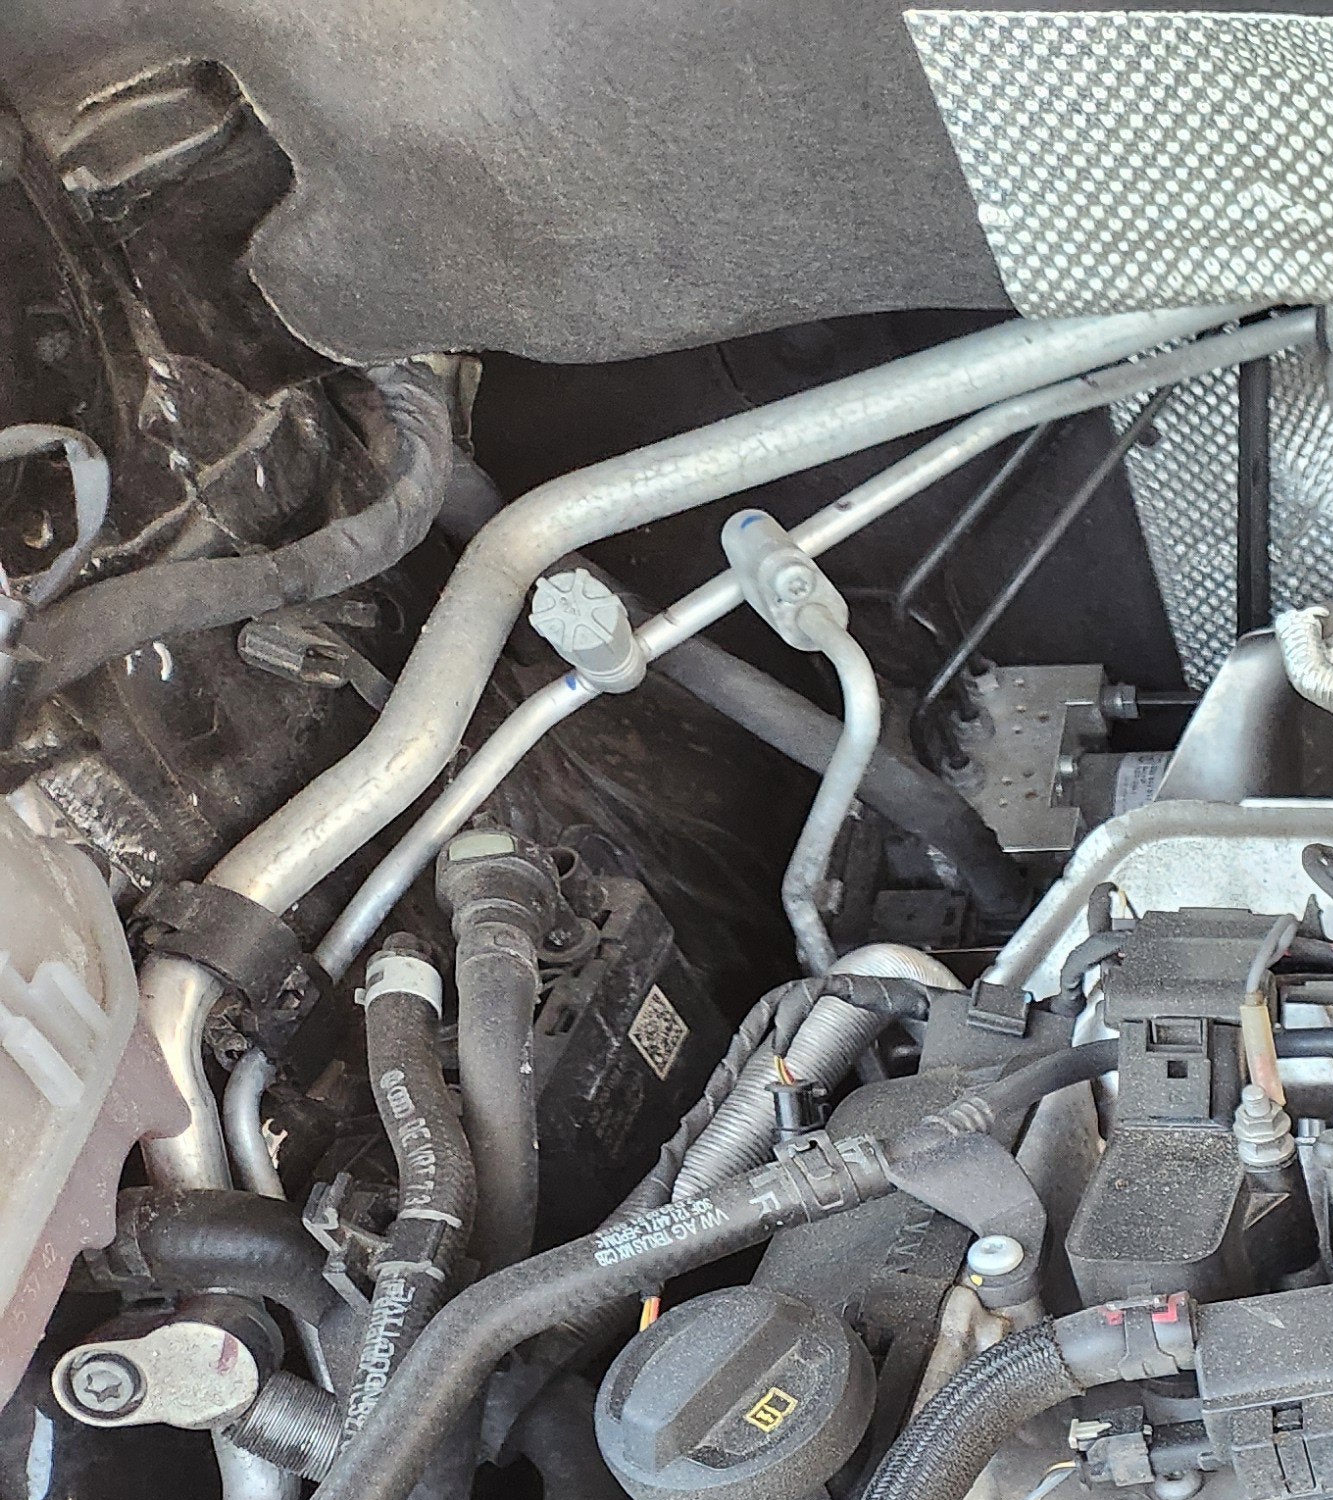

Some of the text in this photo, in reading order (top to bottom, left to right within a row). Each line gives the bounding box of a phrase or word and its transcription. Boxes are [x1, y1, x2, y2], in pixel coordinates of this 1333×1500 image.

[670, 1206, 690, 1222] 121
[701, 1209, 728, 1229] VW
[672, 1219, 696, 1240] AG
